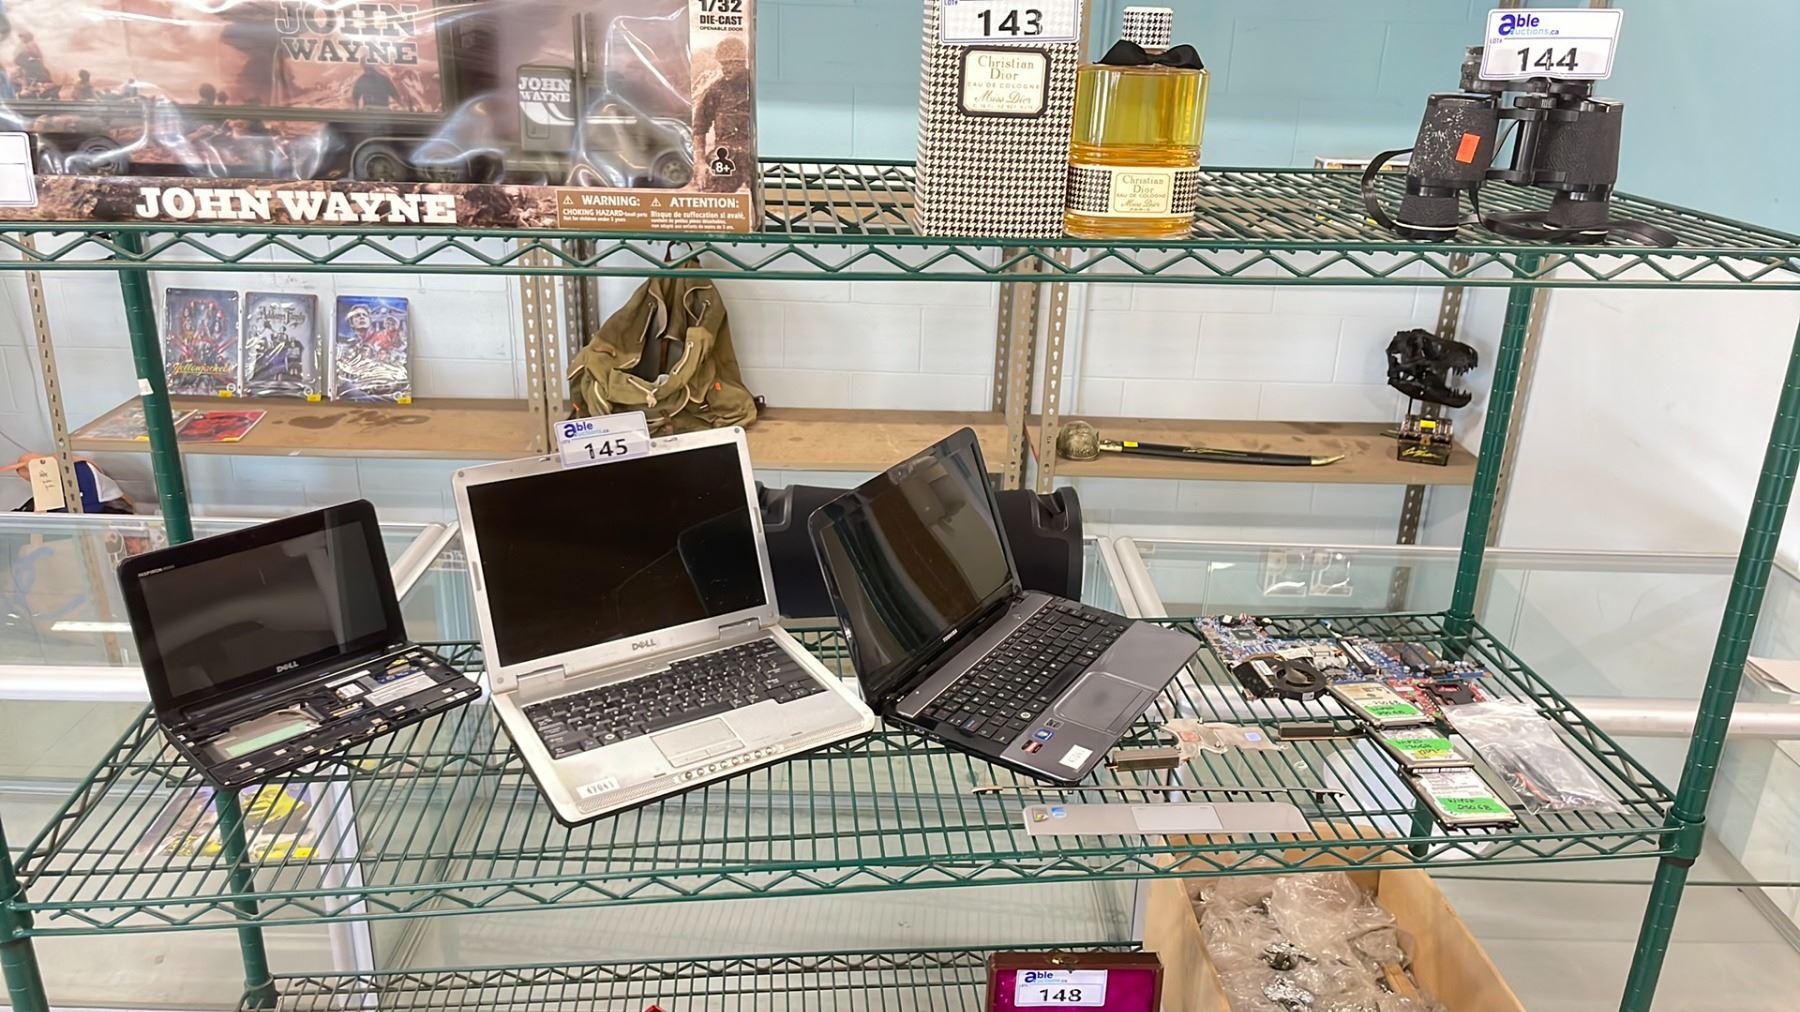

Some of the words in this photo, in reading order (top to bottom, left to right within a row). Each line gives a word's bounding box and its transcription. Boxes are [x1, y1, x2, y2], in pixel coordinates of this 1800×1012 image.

[698, 0, 742, 12] 1/32
[275, 0, 418, 36] JOHN
[700, 15, 743, 25] DIE-CAST
[977, 9, 1043, 36] 143
[1498, 13, 1540, 35] able
[281, 38, 418, 64] WAYNE
[978, 55, 1034, 69] Christian
[1517, 47, 1578, 71] 144
[990, 68, 1019, 80] Dior
[518, 76, 571, 91] JOHN
[520, 91, 570, 102] WAYNE
[715, 162, 730, 173] 8+
[1122, 175, 1164, 184] Christian
[1133, 184, 1154, 193] Dior
[135, 187, 271, 219] JOHN
[277, 190, 457, 223] WAYNE
[581, 194, 640, 206] WARNING:
[670, 197, 739, 208] ATTENTION:
[562, 208, 594, 216] CHOKING
[650, 210, 671, 219] Risque
[563, 422, 593, 438] able
[584, 438, 628, 459] 145
[631, 639, 657, 651] DELL
[276, 660, 299, 672] DELL
[1024, 971, 1054, 983] able
[1040, 988, 1082, 1002] 148
